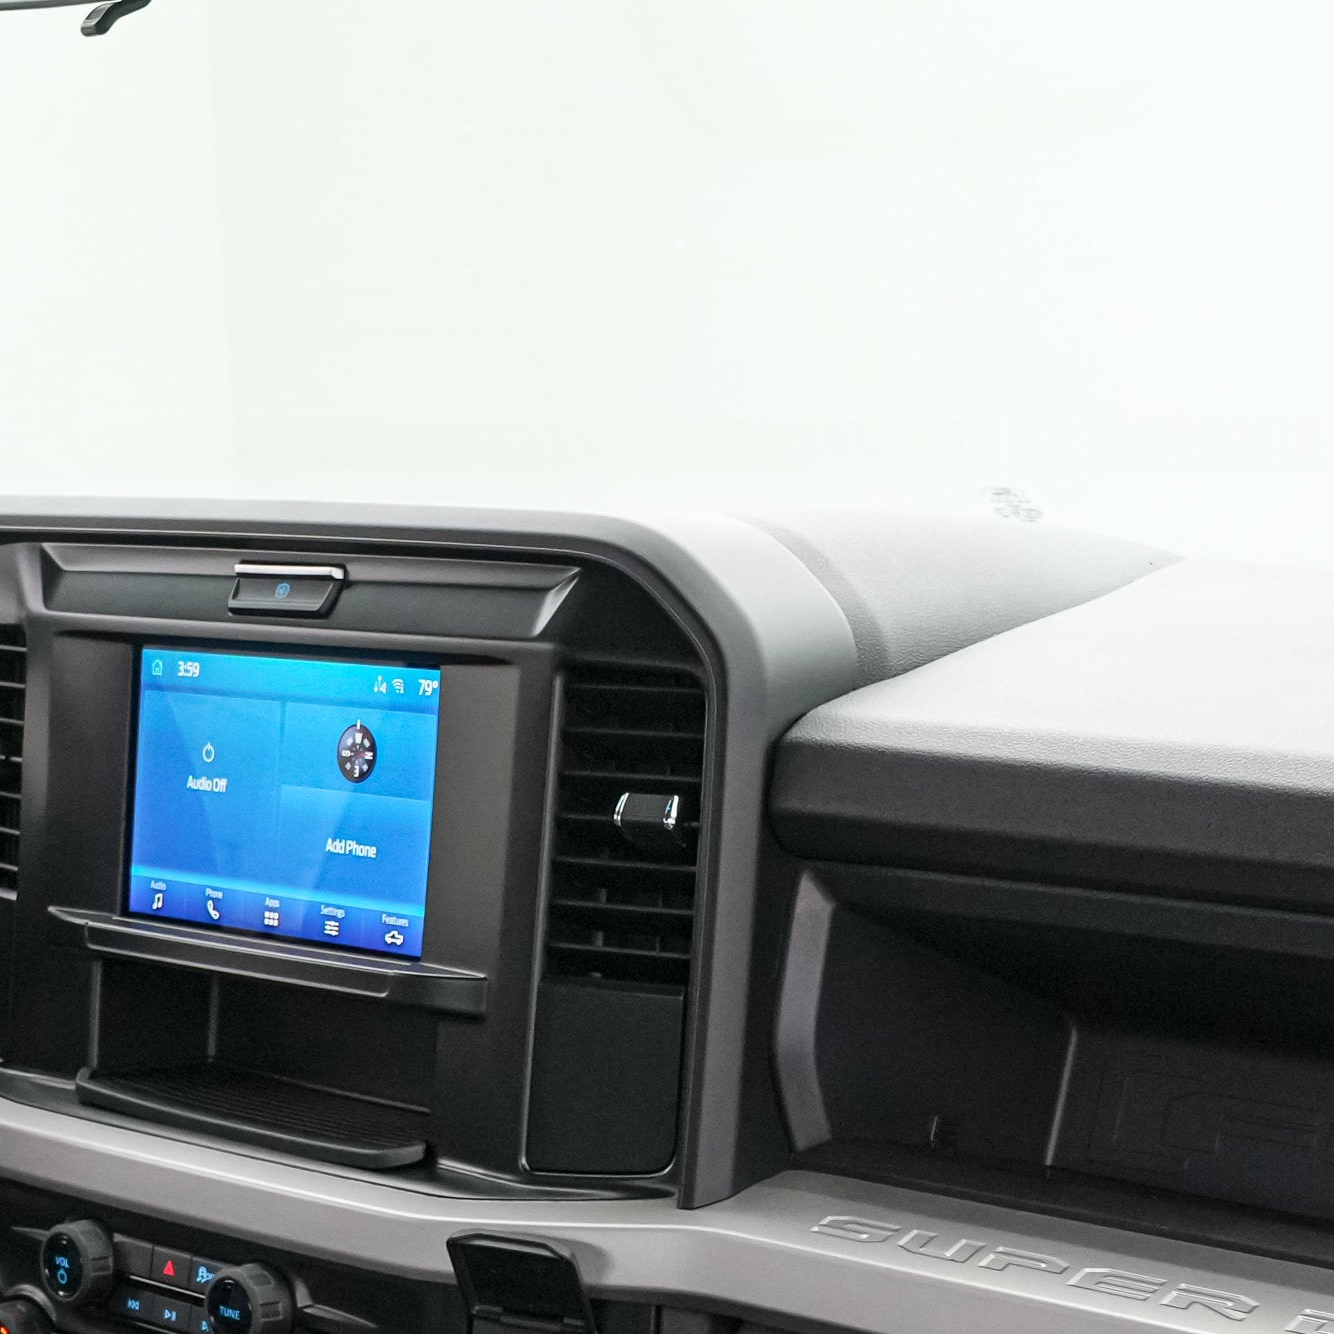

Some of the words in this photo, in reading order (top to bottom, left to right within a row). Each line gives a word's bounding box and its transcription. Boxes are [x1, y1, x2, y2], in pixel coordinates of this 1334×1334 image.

[177, 661, 200, 678] 3:59
[187, 775, 212, 791] Audio
[213, 778, 227, 793] Off
[326, 838, 345, 854] Add
[346, 840, 377, 858] Phone
[381, 913, 409, 927] Features
[55, 1256, 70, 1269] VOL
[811, 1215, 1260, 1322] SUPER
[219, 1305, 241, 1321] TUNE
